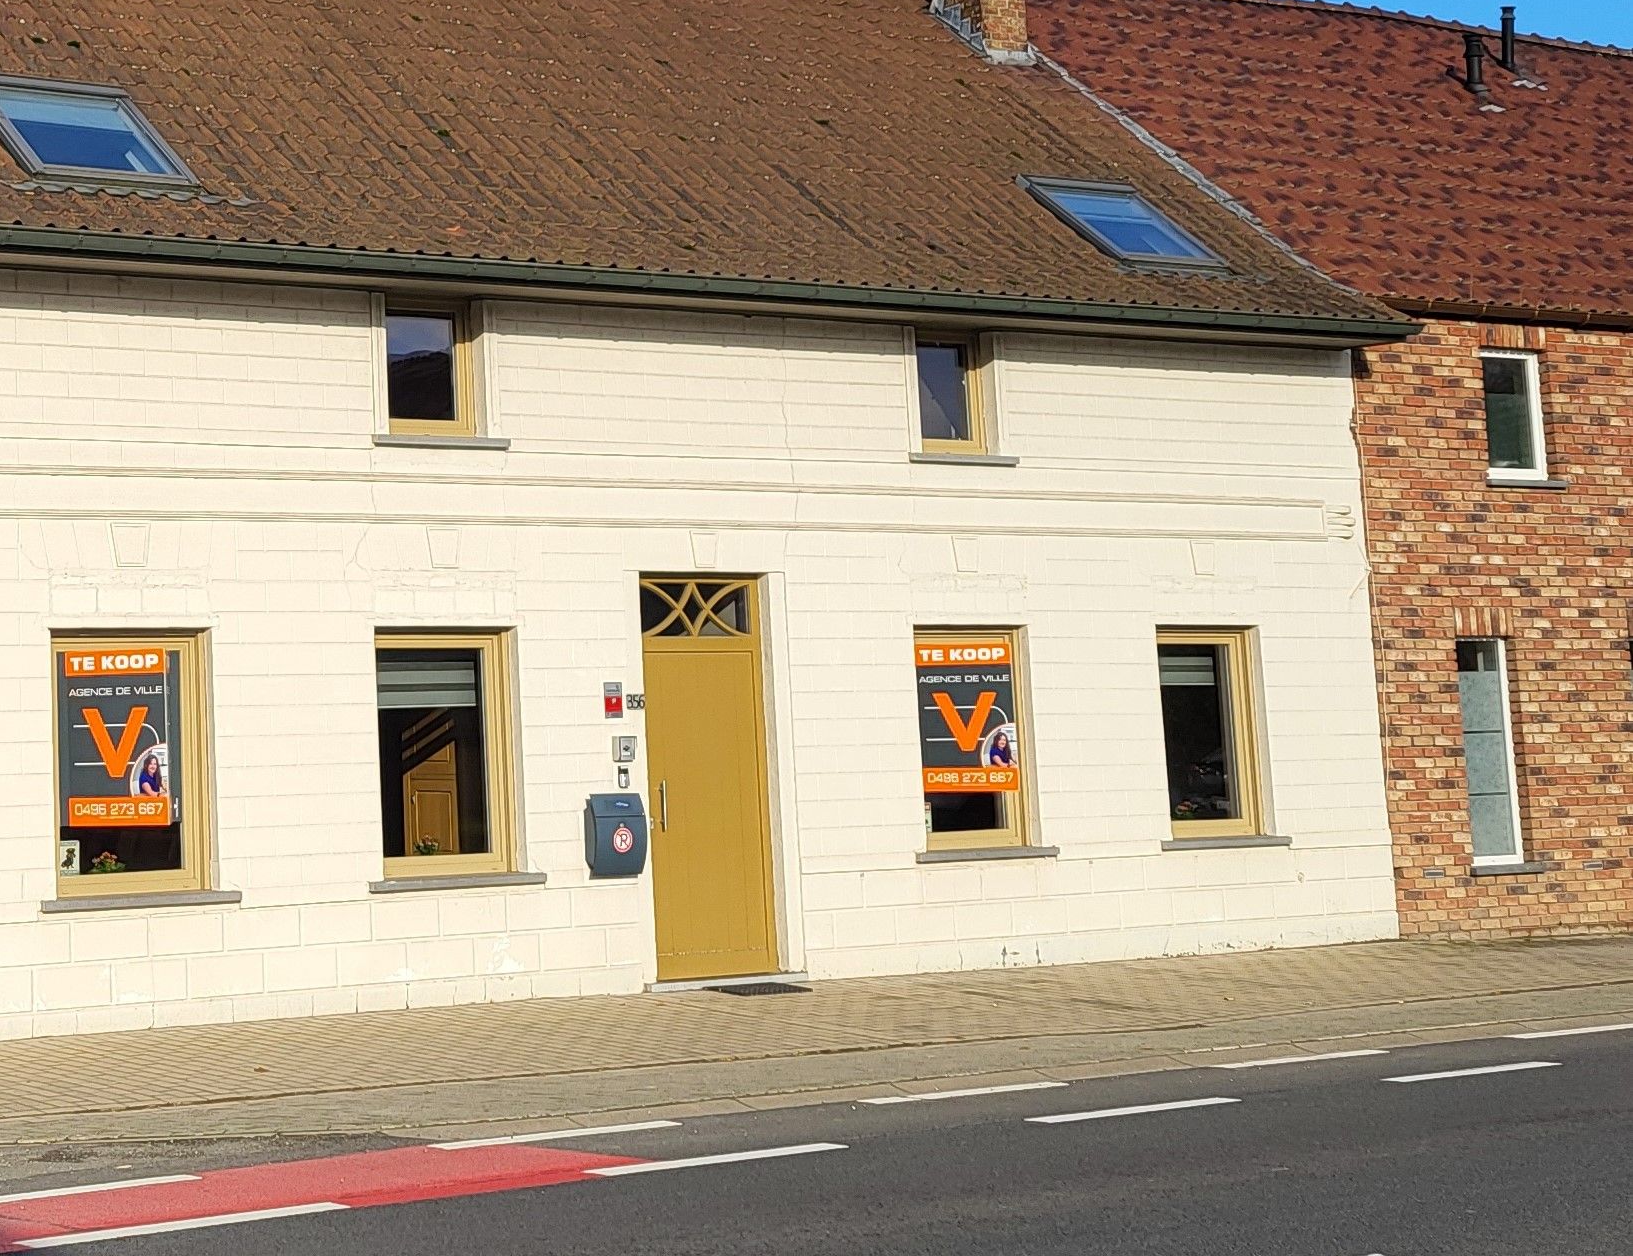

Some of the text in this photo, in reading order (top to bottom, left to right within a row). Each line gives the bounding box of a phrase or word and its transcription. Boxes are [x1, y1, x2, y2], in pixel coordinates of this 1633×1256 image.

[919, 647, 1005, 662] TE KOOP
[70, 653, 159, 672] TE KOOP
[919, 673, 1010, 683] AGENCE DE VILLE
[68, 685, 163, 697] AGENCE DE VILLE
[626, 694, 646, 710] 356
[961, 772, 987, 783] 273
[110, 803, 135, 815] 273
[138, 802, 164, 815] 667
